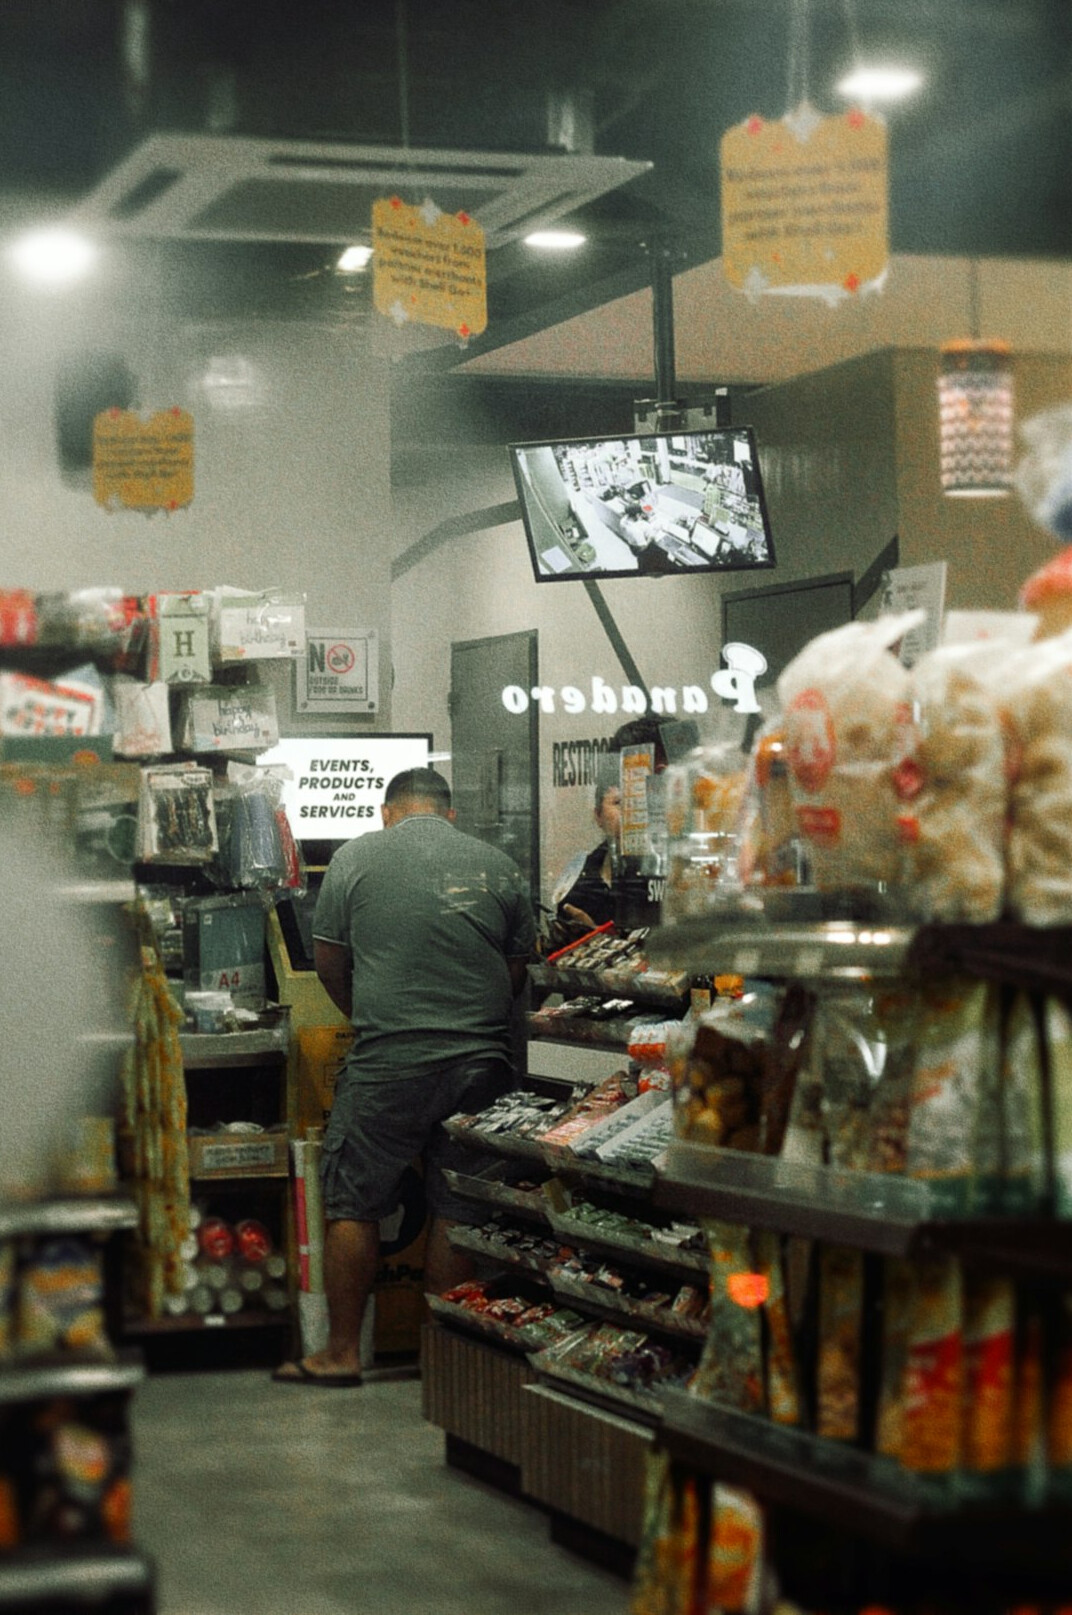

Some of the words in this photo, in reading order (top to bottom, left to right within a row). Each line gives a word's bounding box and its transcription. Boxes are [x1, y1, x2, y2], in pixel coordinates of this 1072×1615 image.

[173, 630, 195, 657] H
[310, 759, 374, 774] EVENTS,
[299, 777, 385, 790] PRODUCTS
[332, 792, 356, 802] AND
[299, 805, 375, 819] SERVICES
[219, 972, 240, 989] A4
